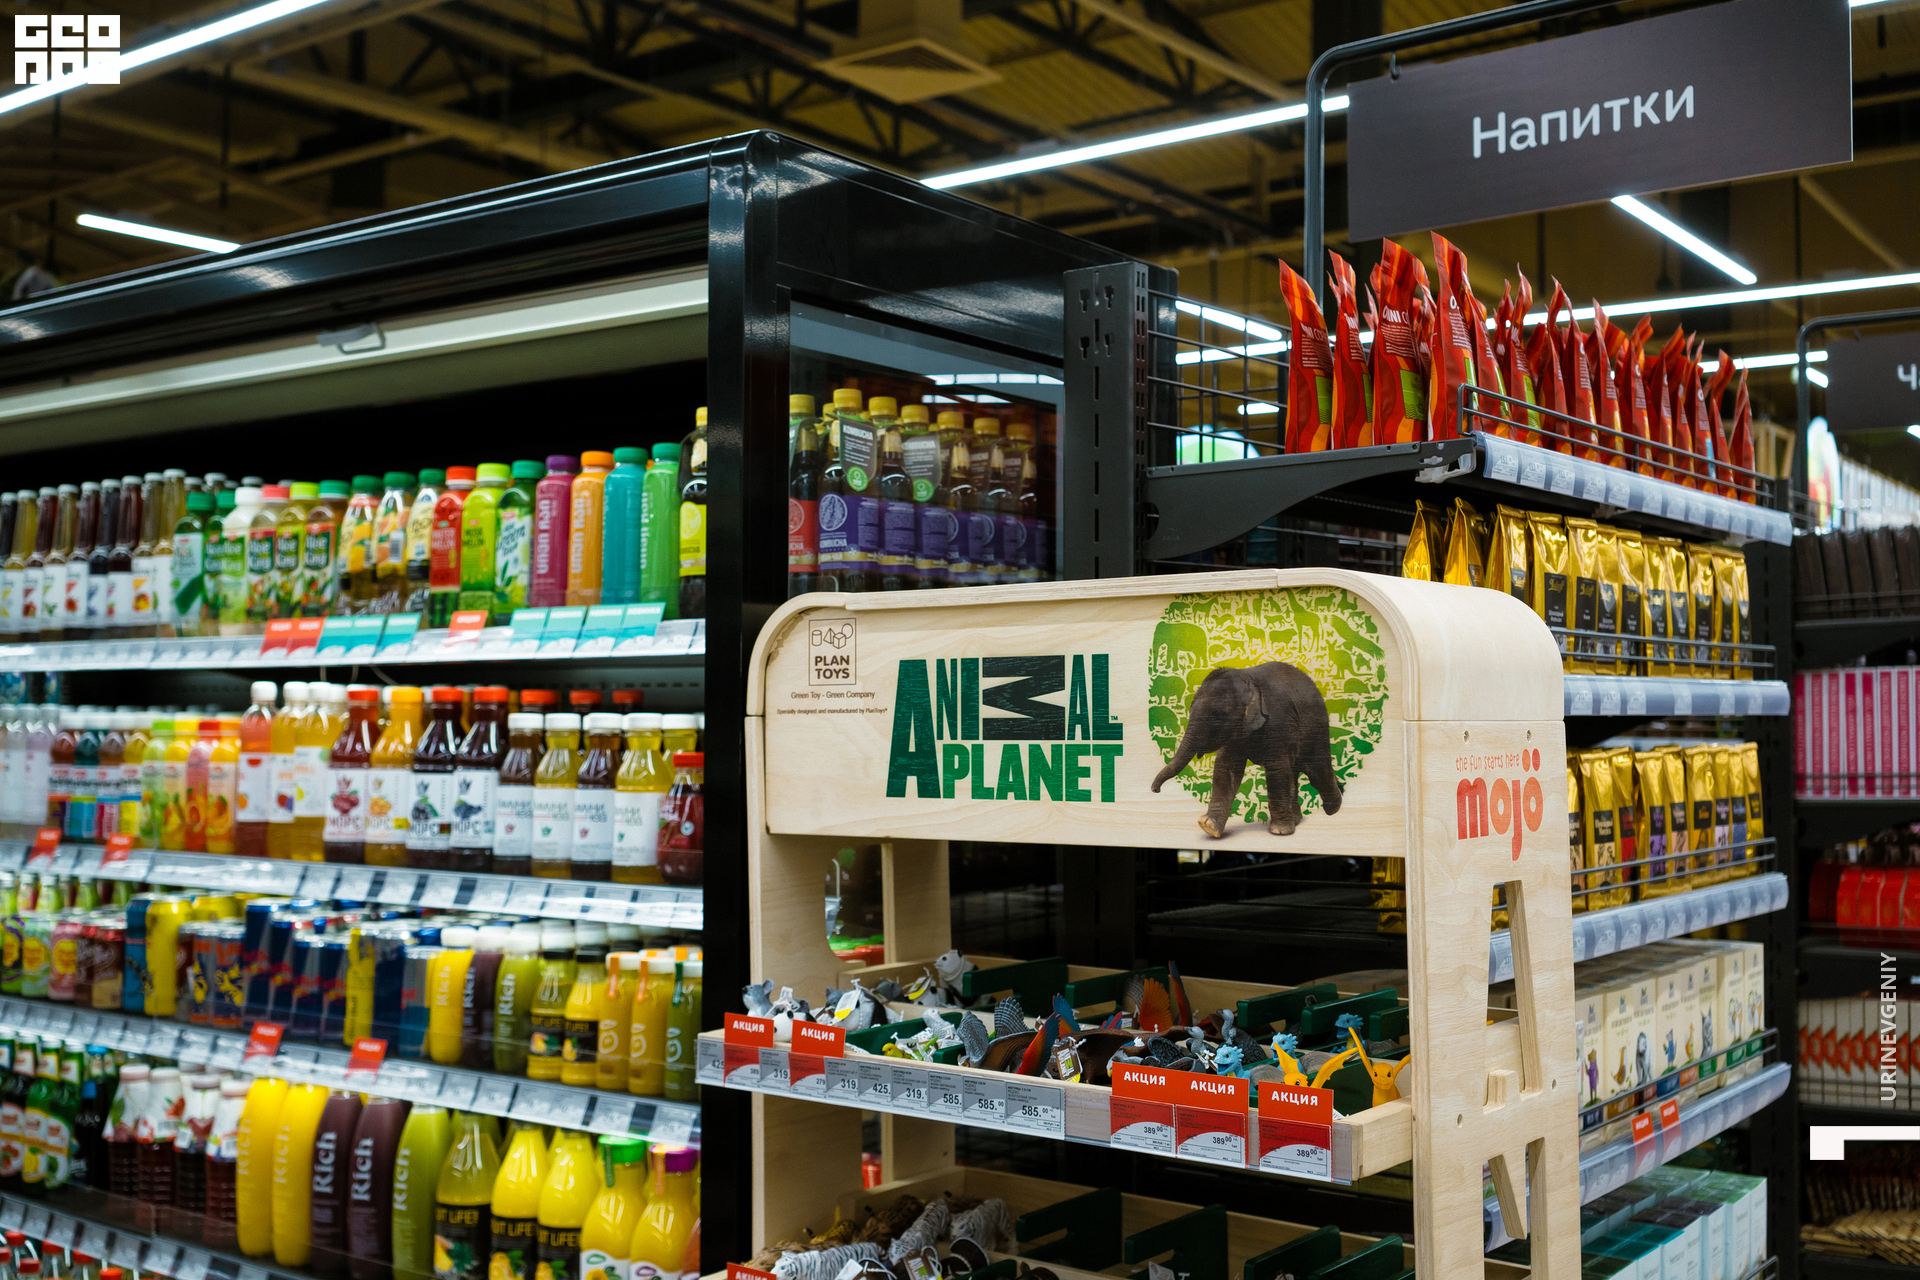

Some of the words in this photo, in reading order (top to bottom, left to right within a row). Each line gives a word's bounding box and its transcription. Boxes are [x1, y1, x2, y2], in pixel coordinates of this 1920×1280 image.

[1473, 85, 1695, 158] Напитки
[1897, 363, 1920, 391] Ч
[814, 655, 850, 667] PLAN
[815, 668, 850, 680] TOYS
[810, 691, 821, 700] Toy
[827, 691, 845, 699] Green
[846, 691, 875, 700] Company
[886, 654, 1124, 798] ANIMAL
[1455, 754, 1468, 772] the
[1469, 753, 1483, 772] fun
[1484, 752, 1504, 770] starts
[1505, 751, 1520, 769] here
[942, 743, 1124, 803] PLANET
[497, 974, 517, 1017] Rich
[733, 1020, 765, 1033] АКЦИЯ
[801, 1027, 835, 1042] АКЦИЯ
[1123, 1071, 1166, 1086] АКЦИЯ
[1190, 1080, 1235, 1095] АКЦИЯ
[1271, 1090, 1318, 1106] АКЦИЯ
[313, 1131, 338, 1194] Rich
[351, 1137, 374, 1202] Rich
[392, 1148, 411, 1212] Rich
